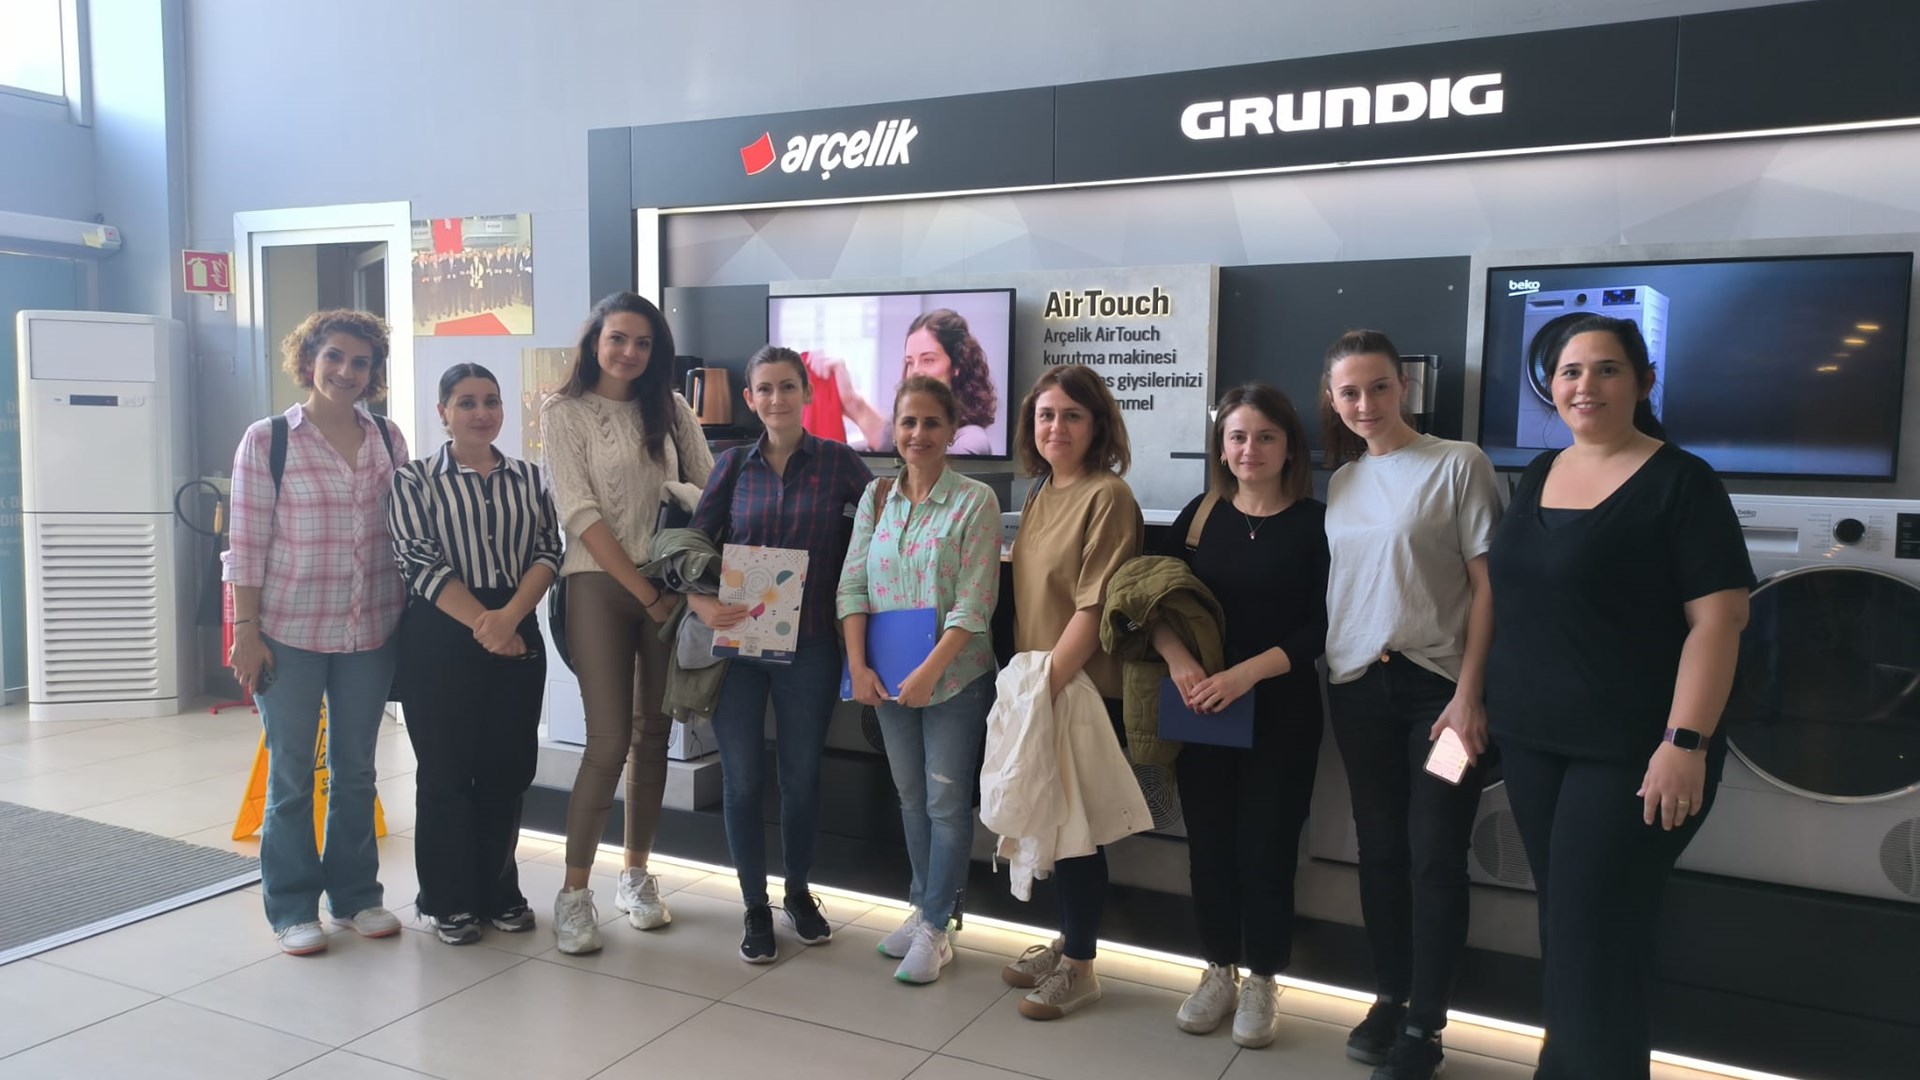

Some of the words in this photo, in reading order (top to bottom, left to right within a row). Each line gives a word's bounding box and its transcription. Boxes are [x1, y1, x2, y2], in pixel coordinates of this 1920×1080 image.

[1180, 72, 1504, 140] GRUNDIG
[780, 118, 918, 180] arçelik
[1508, 279, 1541, 291] beko
[1044, 287, 1169, 318] AirTouch
[1043, 327, 1092, 346] Arçelik
[1095, 325, 1160, 342] AirTouch
[1043, 349, 1105, 365] kurutma
[1108, 349, 1177, 365] makinesi
[1117, 372, 1203, 391] giysilerinizi
[1115, 394, 1154, 411] mmel
